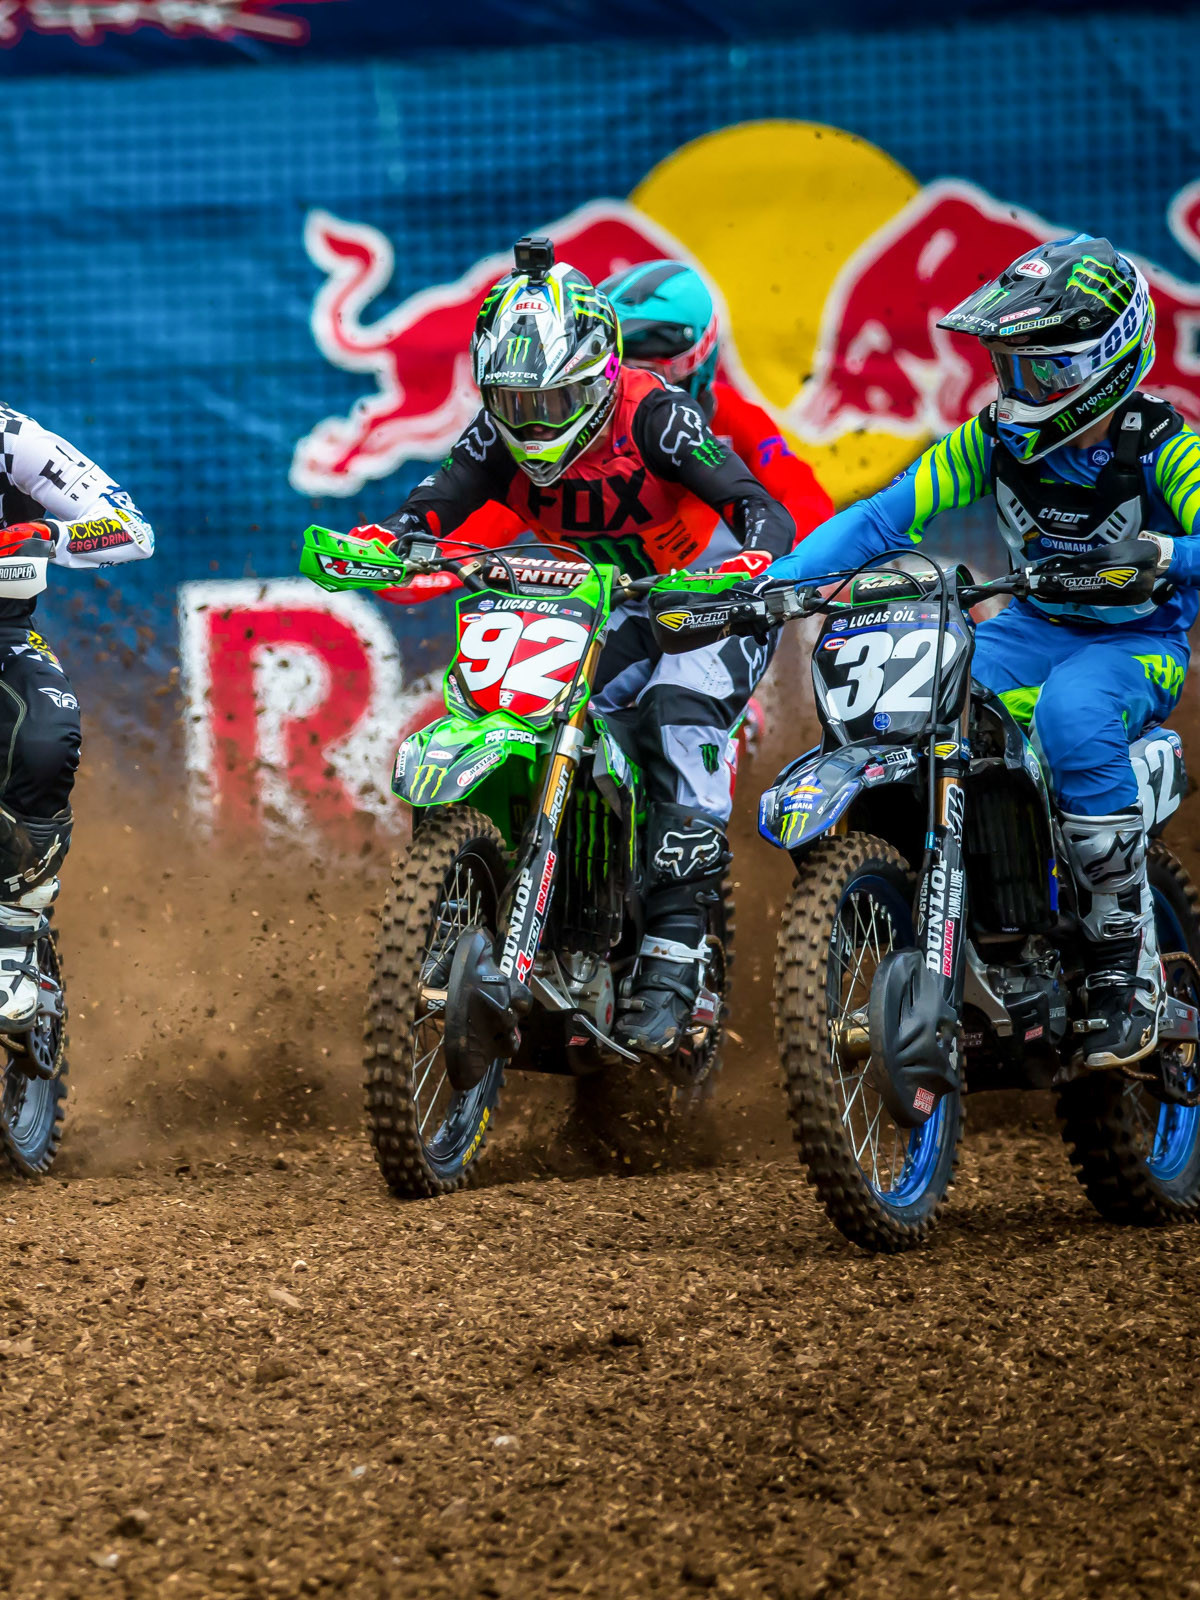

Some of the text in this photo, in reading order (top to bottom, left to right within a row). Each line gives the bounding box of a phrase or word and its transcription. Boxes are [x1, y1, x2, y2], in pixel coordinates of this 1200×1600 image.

[1021, 262, 1044, 275] BELL
[515, 300, 544, 311] BELL
[946, 312, 999, 332] MONSTER
[1000, 315, 1062, 335] apdesigns
[485, 370, 538, 381] MONSTER
[1075, 362, 1134, 415] MONSTER
[1149, 418, 1170, 439] thor
[528, 466, 654, 532] FOX
[1038, 507, 1090, 524] thor
[1052, 540, 1093, 553] YAMAHA
[490, 555, 592, 571] RENTHA
[488, 566, 589, 586] RENTHA
[1064, 576, 1107, 587] CYCRA
[494, 599, 536, 611] LUCAS
[536, 601, 560, 614] OIL
[682, 611, 730, 626] CYCRA
[849, 610, 916, 628] LUCAS OIL
[459, 611, 590, 700] 92
[826, 628, 958, 722] 32
[485, 729, 537, 745] PRO CIRCU
[784, 802, 813, 812] YAMAHA
[536, 850, 557, 915] BRAKING
[948, 867, 964, 919] YAMALUBE
[500, 867, 534, 978] DUNLOP
[942, 919, 955, 978] BRAKING
